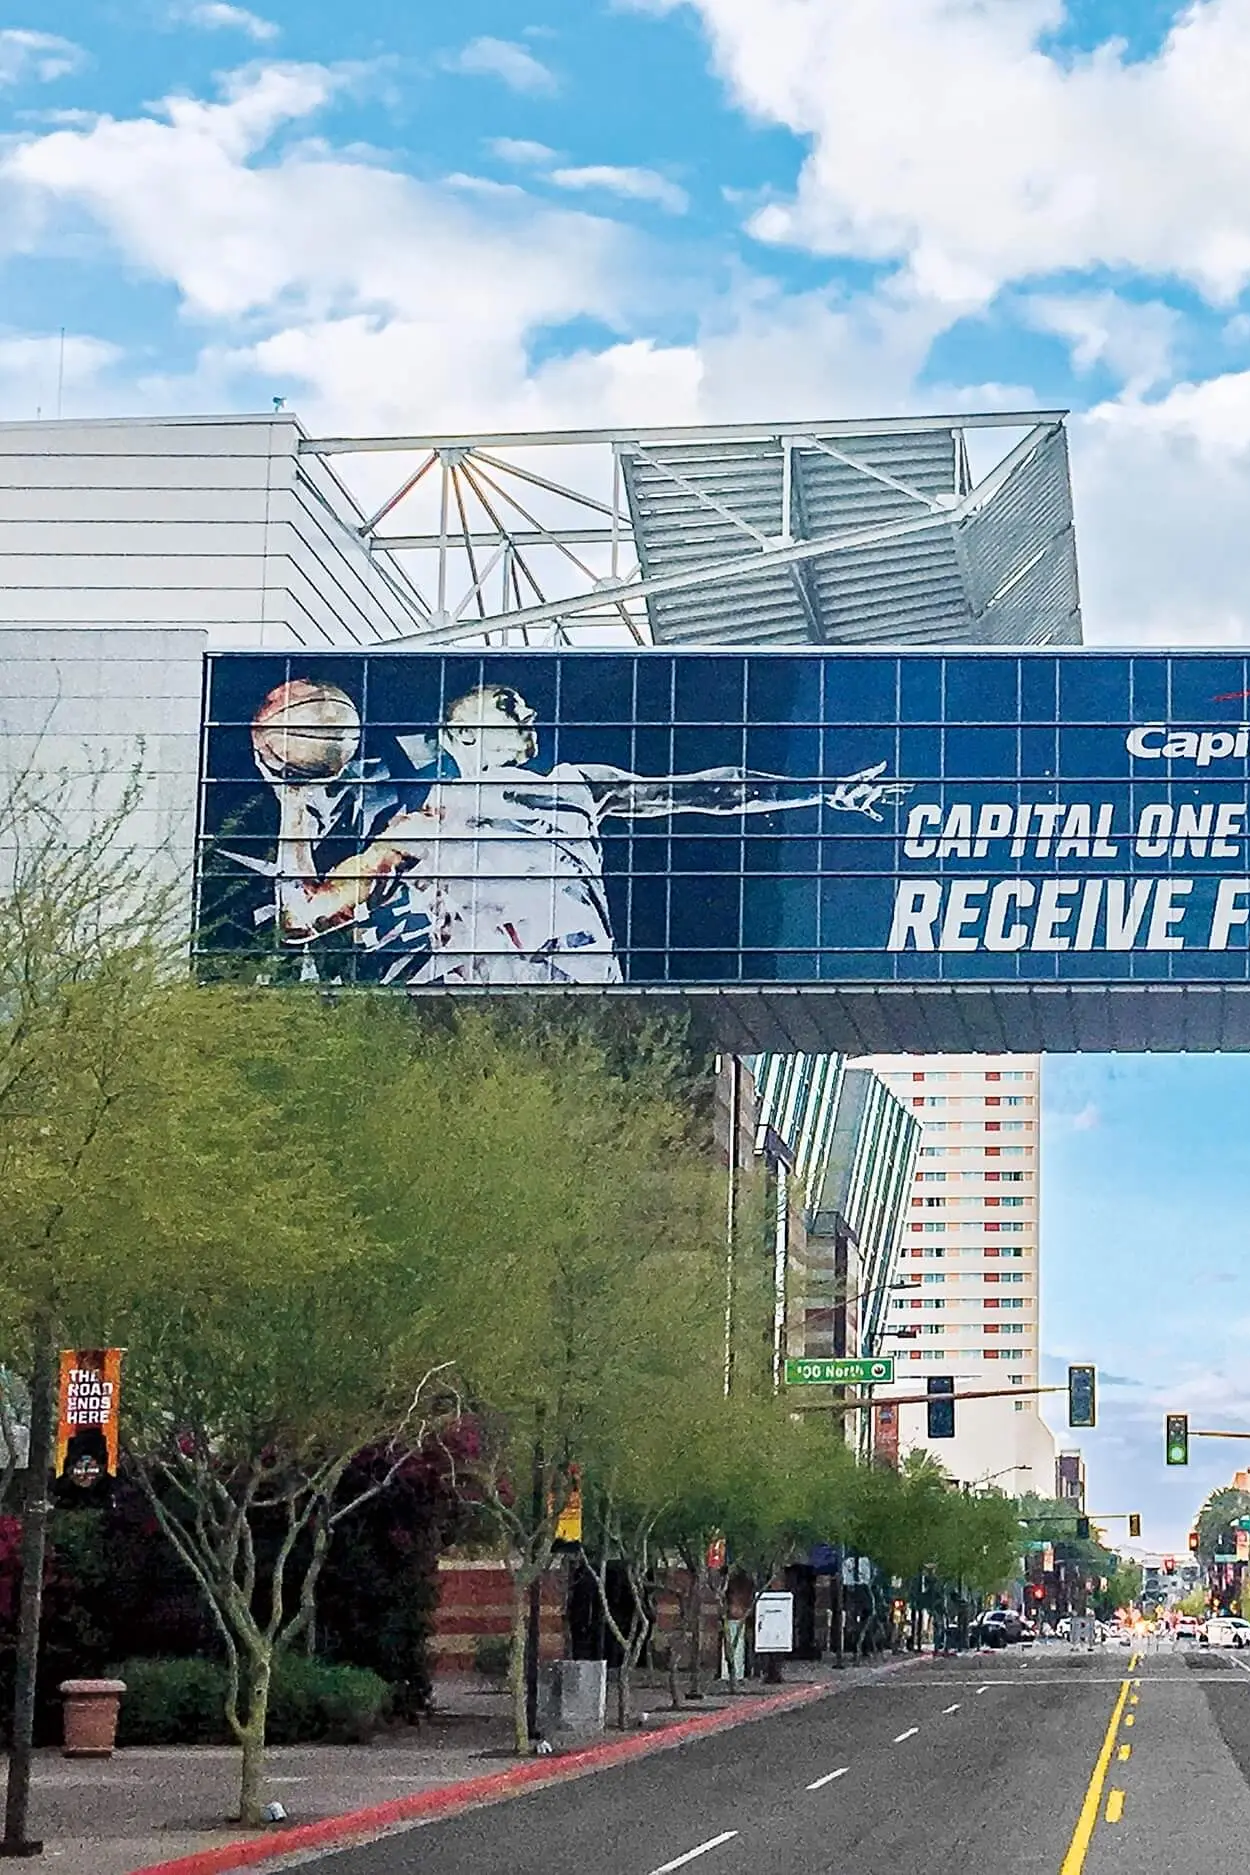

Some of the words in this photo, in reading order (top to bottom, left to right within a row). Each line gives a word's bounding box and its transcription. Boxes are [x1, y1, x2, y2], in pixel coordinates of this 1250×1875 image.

[903, 803, 1115, 858] CAPITAL
[1134, 803, 1247, 858] ONE
[887, 879, 1194, 952] RECEIVE
[69, 1369, 100, 1382] THE
[68, 1382, 113, 1396] ROAD
[67, 1397, 111, 1410] ENDS
[67, 1410, 109, 1424] HERE
